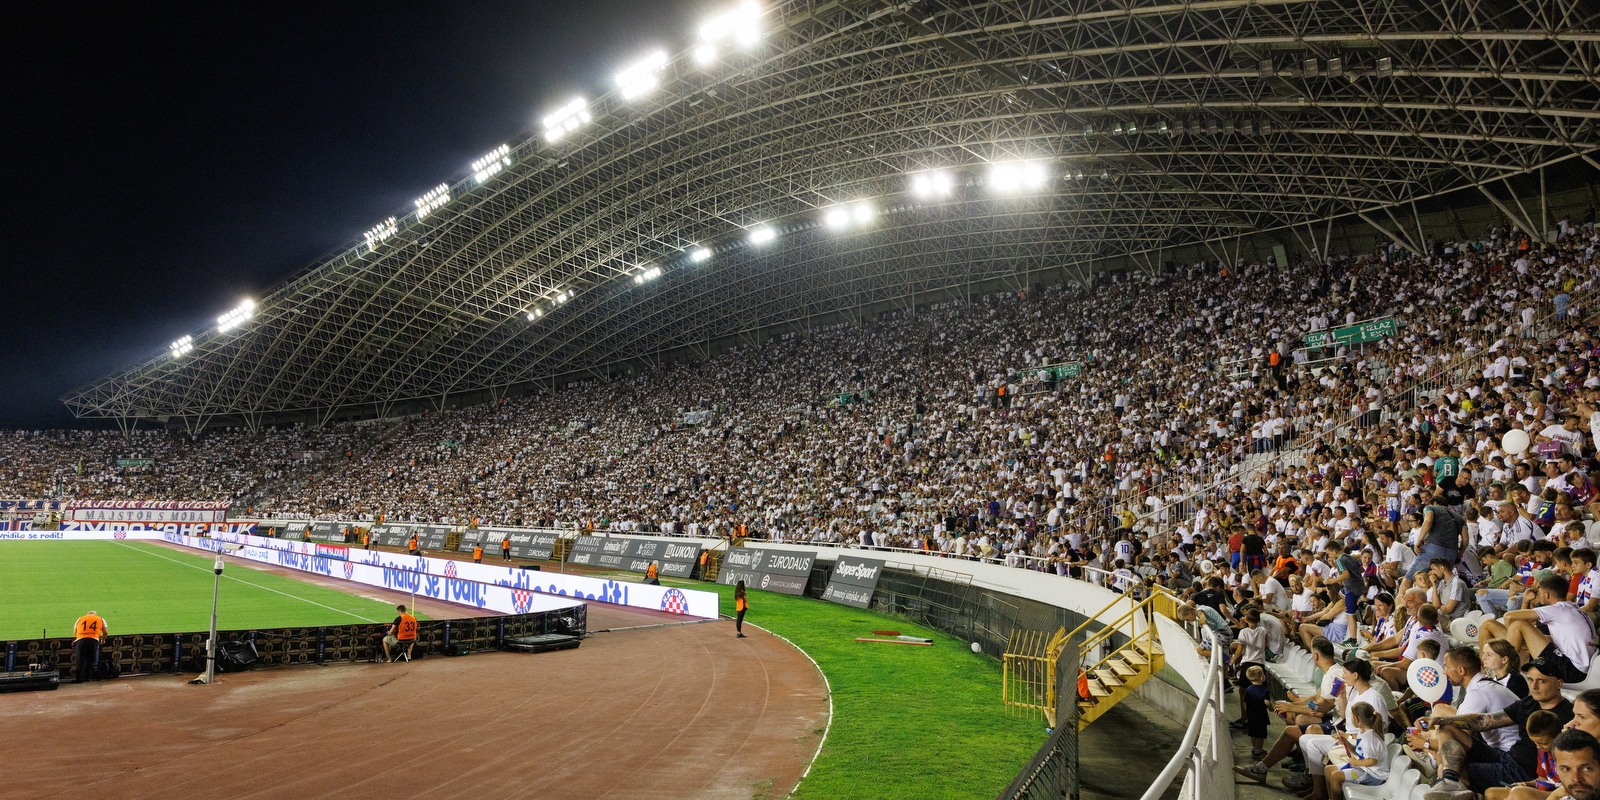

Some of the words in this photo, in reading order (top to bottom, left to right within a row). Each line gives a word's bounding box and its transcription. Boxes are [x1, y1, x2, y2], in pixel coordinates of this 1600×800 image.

[1366, 321, 1392, 332] IZLAZ
[1307, 333, 1326, 342] IZLA
[577, 536, 602, 547] ADRIATIC
[671, 546, 697, 558] LUKOIL
[1120, 544, 1130, 554] 10
[768, 555, 811, 571] EURODAUS
[836, 560, 878, 580] SuperSport
[662, 588, 687, 606] HAJDUK
[81, 620, 98, 632] 14
[404, 621, 416, 632] 33
